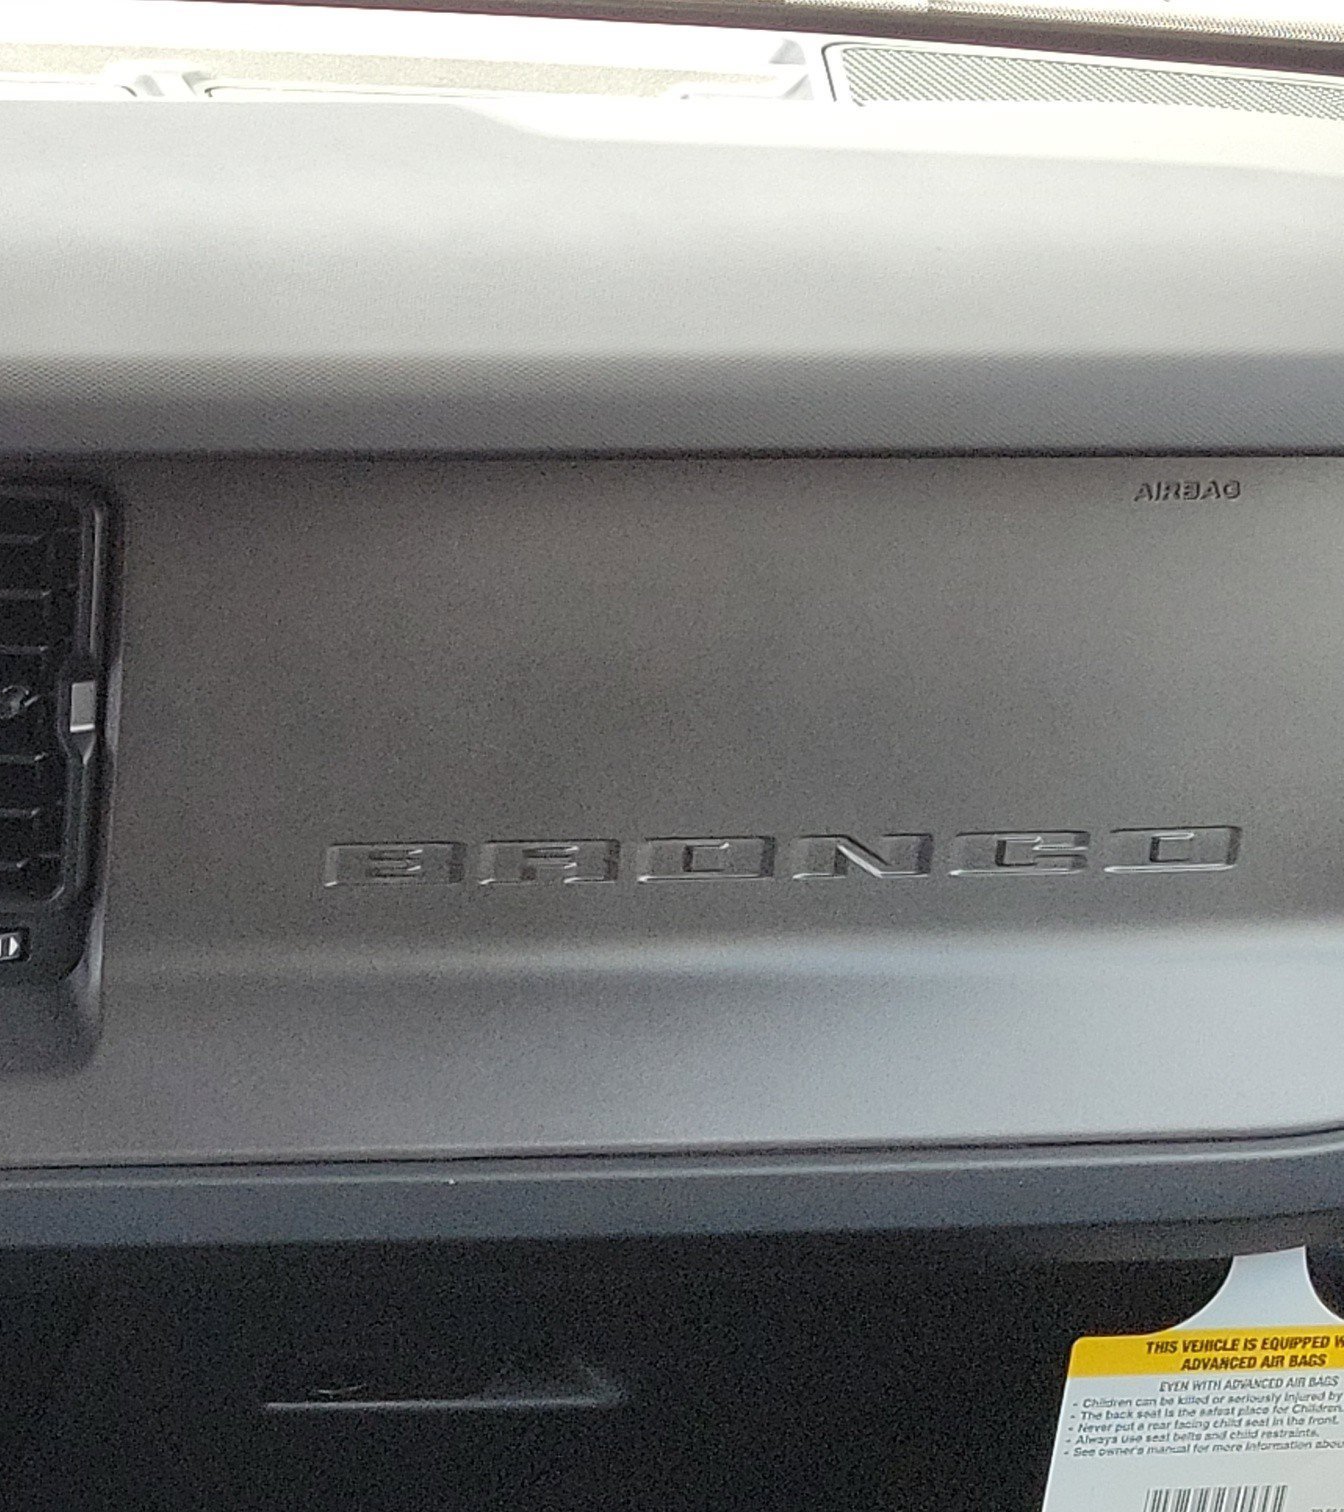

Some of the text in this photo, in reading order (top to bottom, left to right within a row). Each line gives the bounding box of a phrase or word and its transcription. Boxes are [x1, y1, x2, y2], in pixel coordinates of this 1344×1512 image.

[1133, 479, 1241, 502] AIRBAG
[324, 825, 1244, 886] BRONCO
[1146, 1340, 1178, 1354] THIS
[1182, 1338, 1241, 1353] VEHICLE
[1243, 1337, 1258, 1351] IS
[1260, 1335, 1331, 1351] EQUIPPED
[1180, 1353, 1328, 1371] ADVANCED AIR BAGS
[1159, 1375, 1340, 1392] EVEN WITH ADVANCED AIR BAGS
[1080, 1411, 1102, 1420] The
